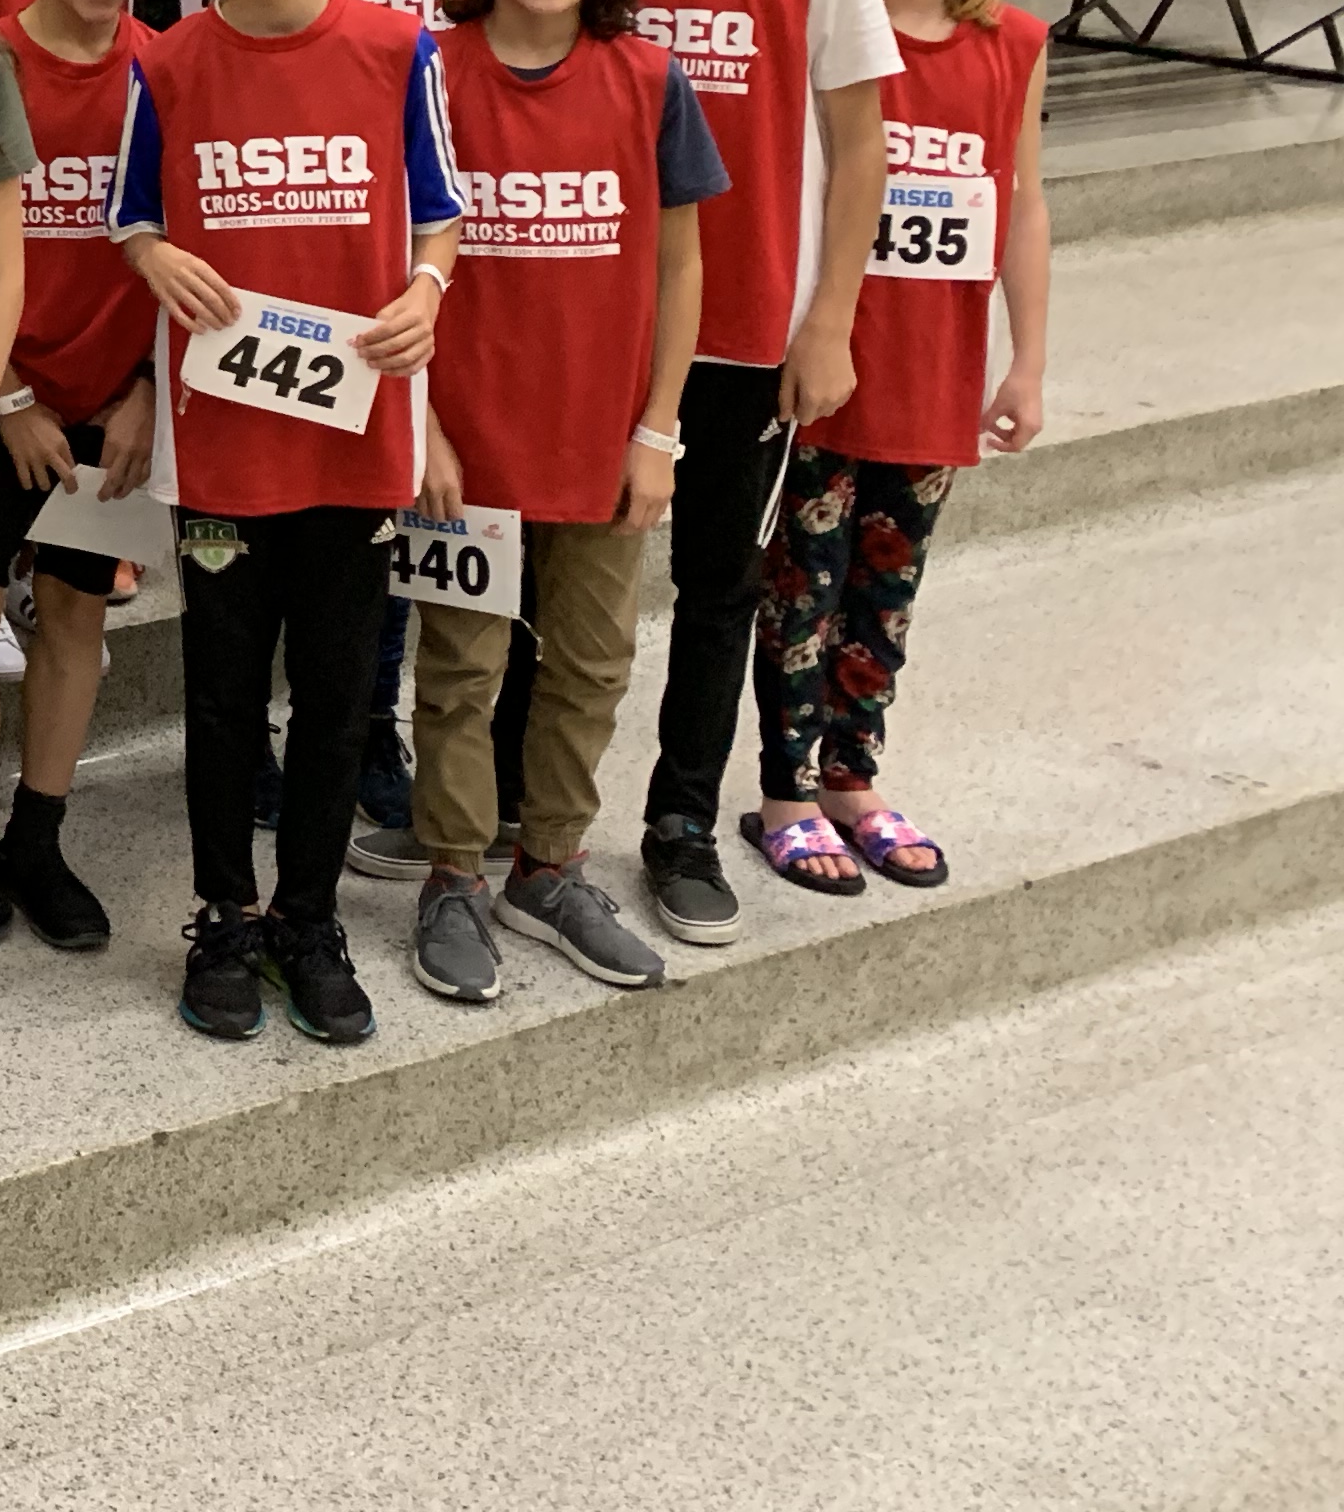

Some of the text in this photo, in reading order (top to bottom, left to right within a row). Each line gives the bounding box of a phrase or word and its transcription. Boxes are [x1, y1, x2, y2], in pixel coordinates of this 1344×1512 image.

[193, 134, 375, 190] RSEQ
[200, 189, 369, 215] CROSS-COUNTRY
[459, 170, 628, 218] RSEQ
[888, 188, 954, 207] RSEQ
[462, 221, 621, 243] ROSS-COUNTRY
[872, 213, 970, 266] 435
[257, 310, 333, 344] RSEQ
[217, 334, 345, 410] 442
[391, 533, 490, 597] 440
